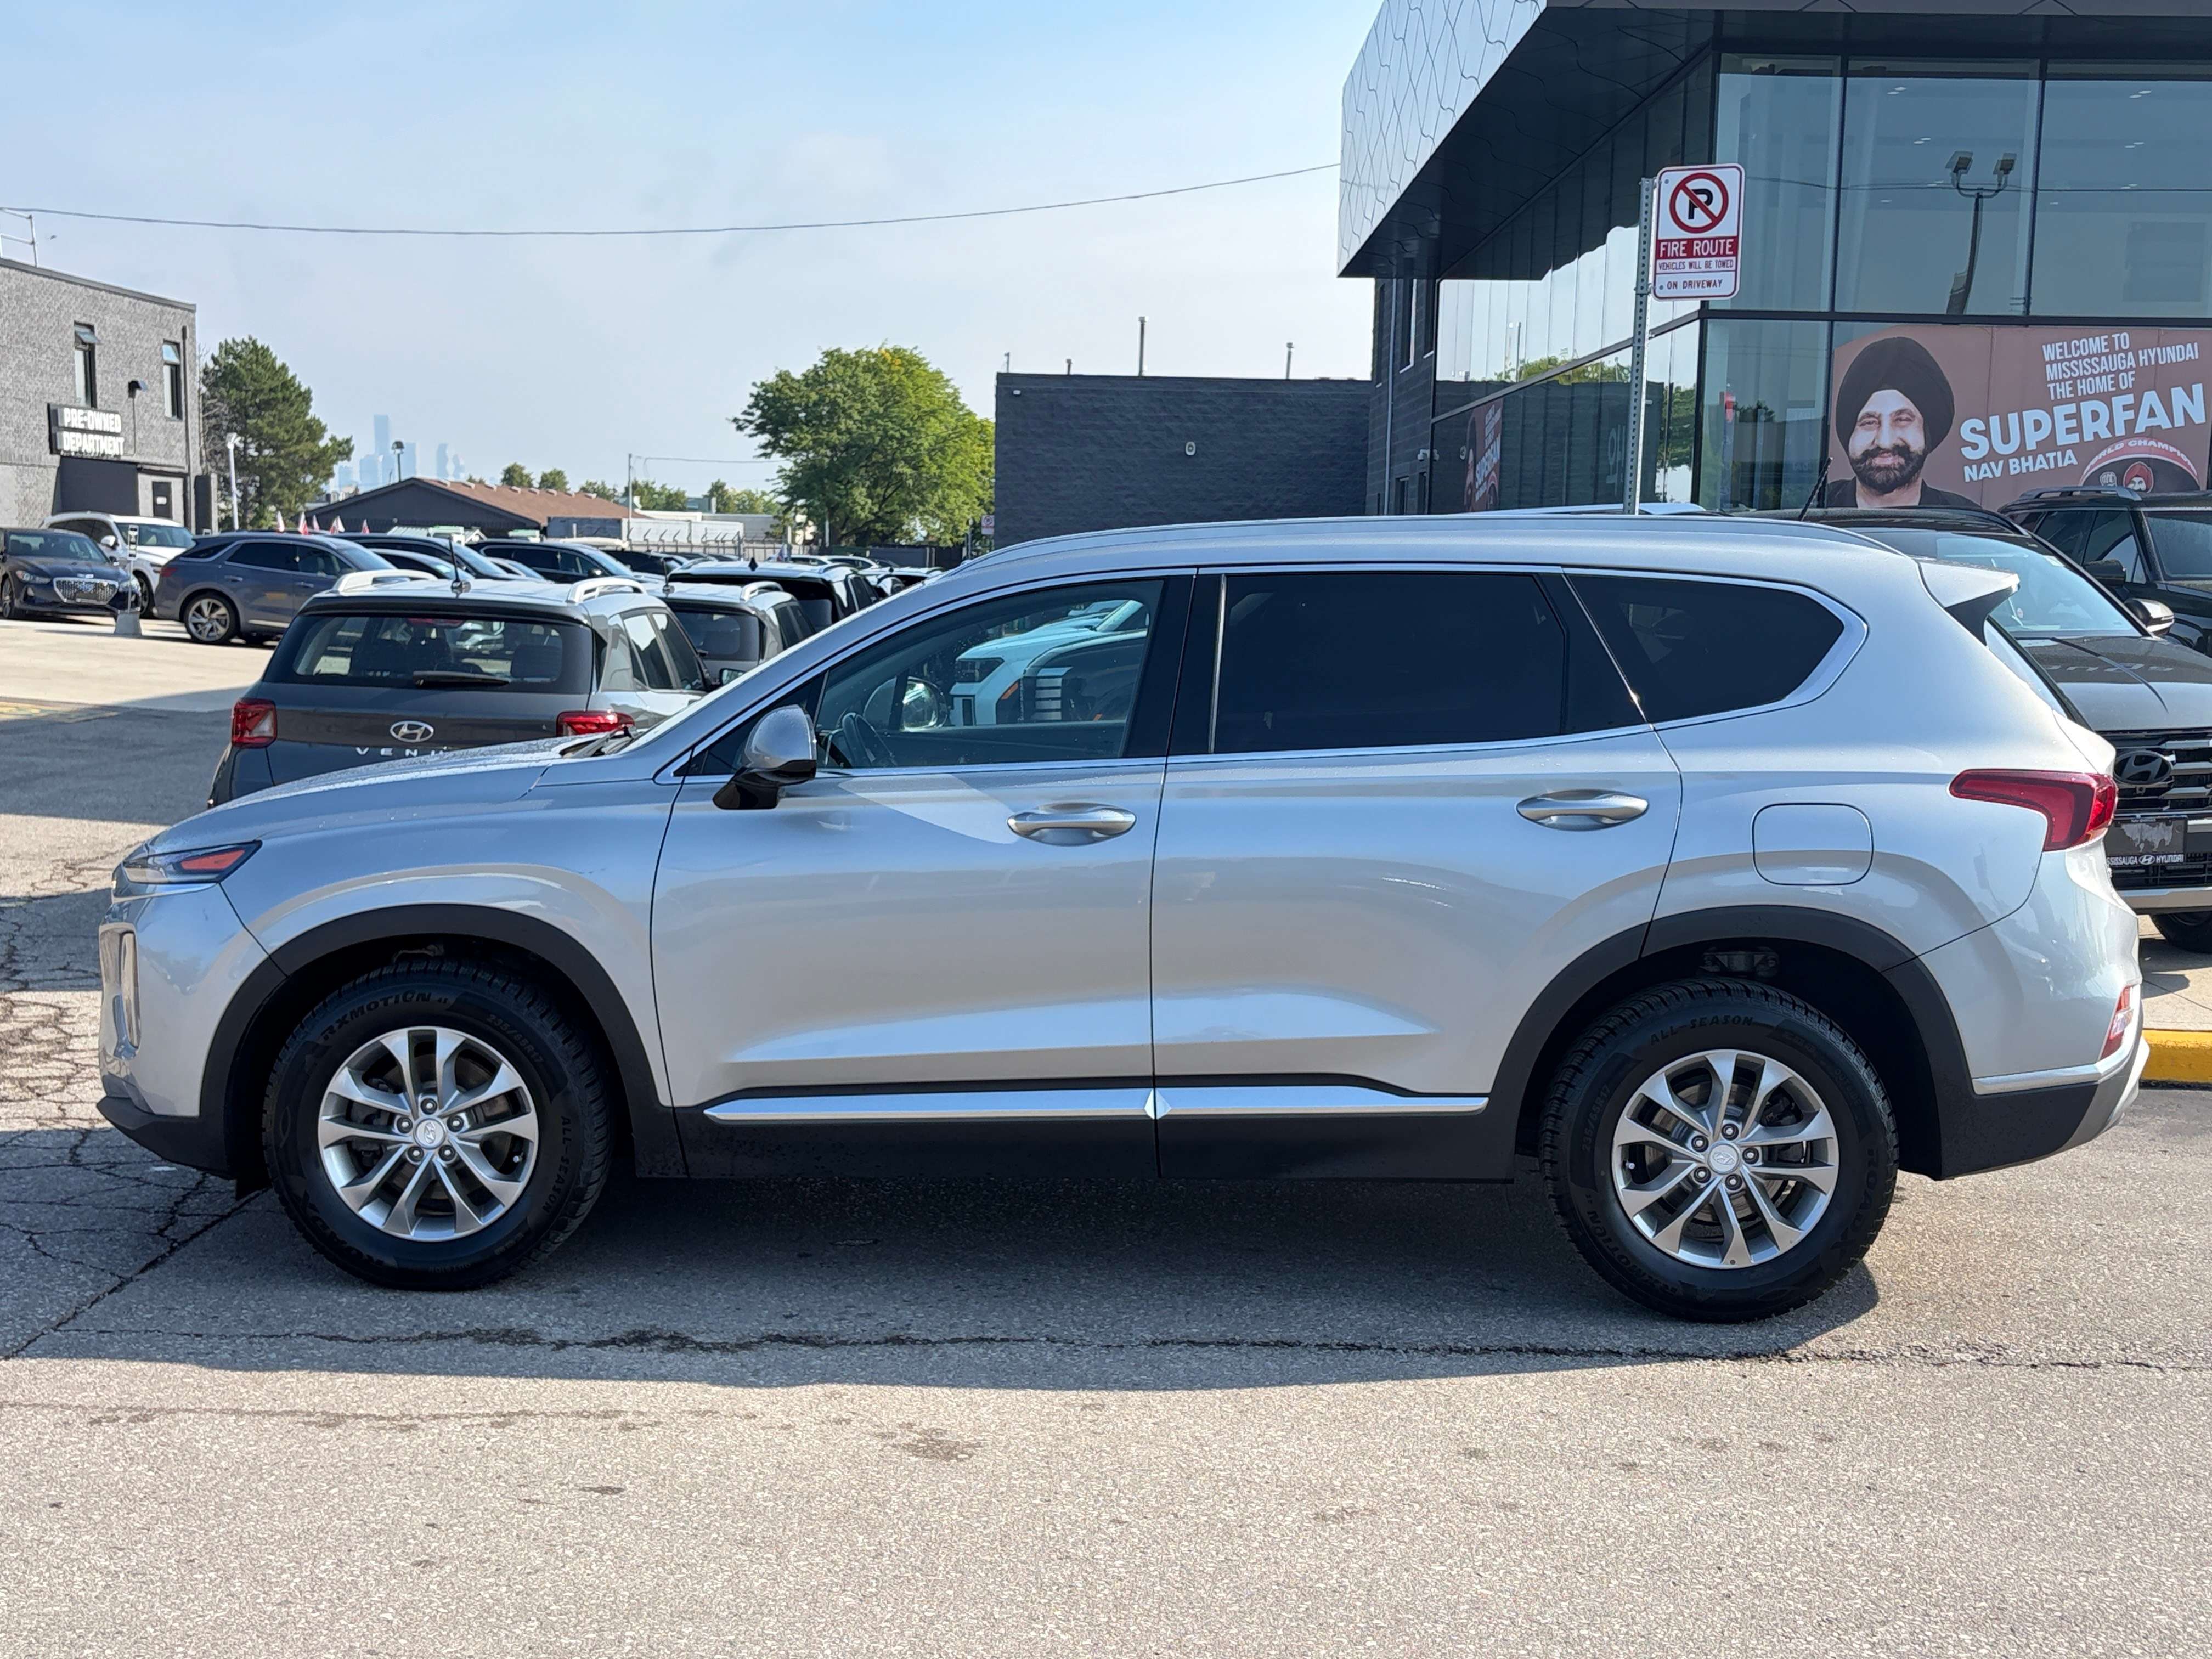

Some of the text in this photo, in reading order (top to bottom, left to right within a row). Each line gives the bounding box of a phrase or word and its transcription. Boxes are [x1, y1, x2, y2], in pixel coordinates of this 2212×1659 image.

[1660, 239, 1734, 257] FIRE ROUTE
[1659, 259, 1734, 270] VEHICLES WILL BE TOWED
[1667, 279, 1723, 290] ON DRIVEWAY
[2042, 332, 2130, 362] WELCOME TO
[2045, 342, 2199, 381] MISSISSAUGA HYUNDAI
[2047, 371, 2136, 400] THE HOME OF
[64, 407, 121, 433] PRE-OWNED
[1960, 383, 2207, 460] SUPERFAN
[62, 431, 125, 455] DEPARTMENT
[1963, 449, 2078, 483] NAV BHATIA
[356, 747, 444, 757] VENU
